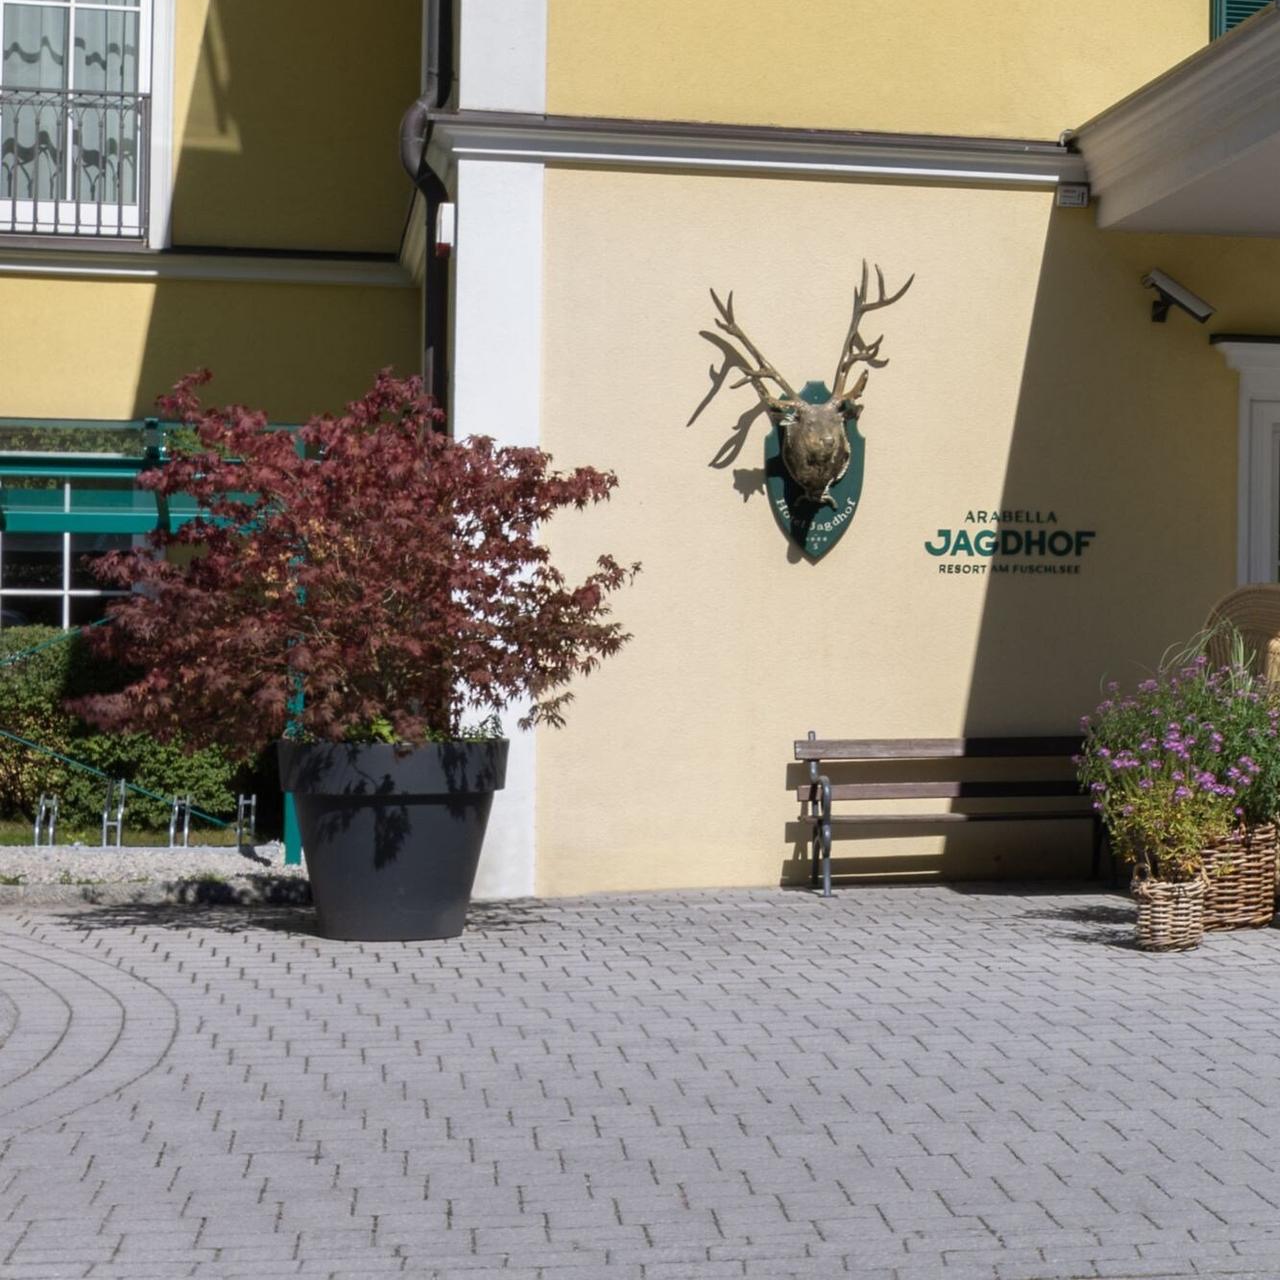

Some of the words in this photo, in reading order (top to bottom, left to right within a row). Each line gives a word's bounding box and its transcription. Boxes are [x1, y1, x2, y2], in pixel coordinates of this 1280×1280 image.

[809, 497, 856, 532] Jagdhof
[964, 510, 1058, 523] ARABELLA
[924, 529, 1096, 556] JAGDHOF
[939, 564, 987, 574] RESORT
[992, 564, 1009, 574] AM
[1012, 564, 1081, 575] FUSCHLSEE
